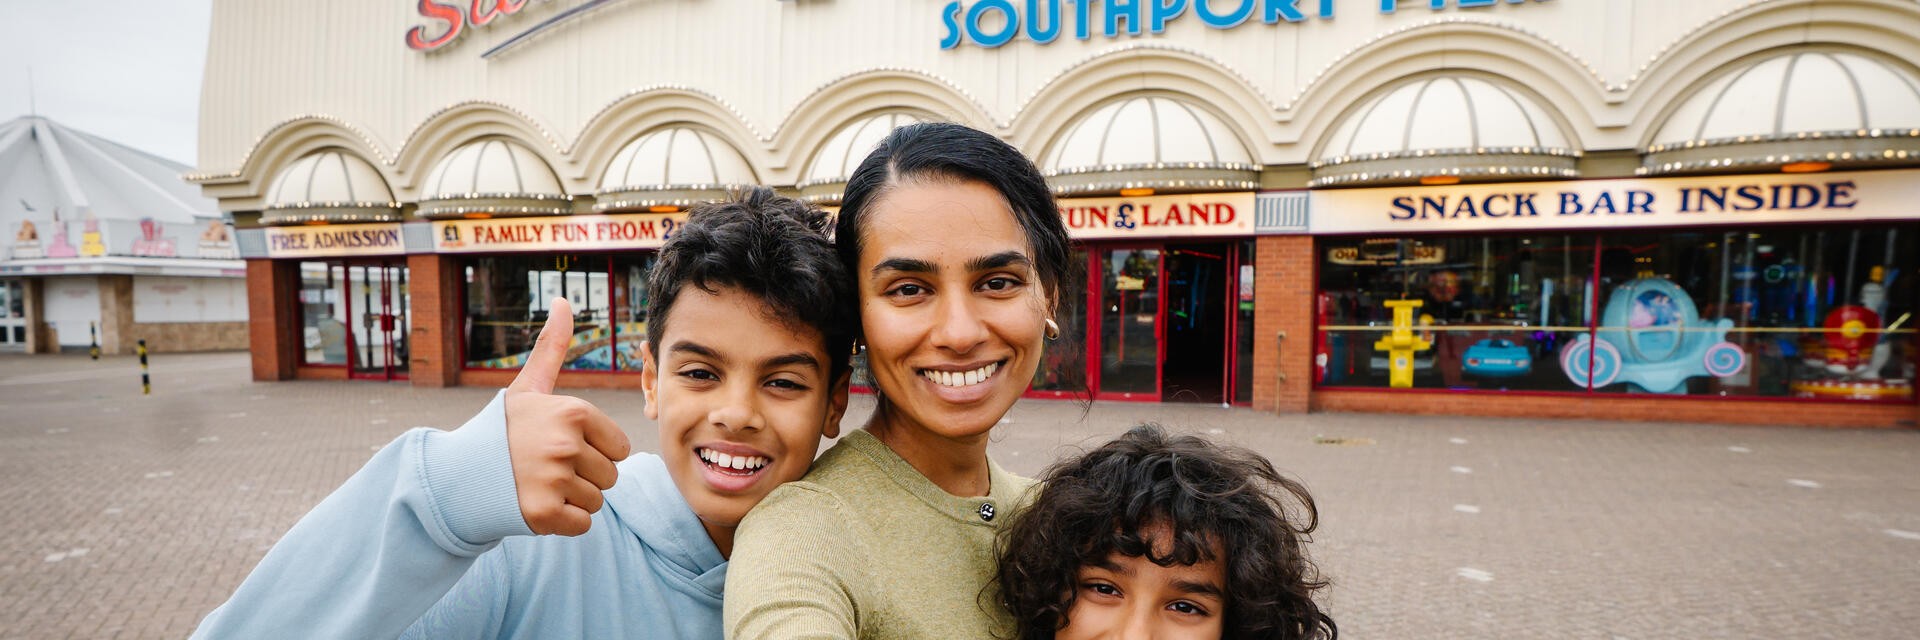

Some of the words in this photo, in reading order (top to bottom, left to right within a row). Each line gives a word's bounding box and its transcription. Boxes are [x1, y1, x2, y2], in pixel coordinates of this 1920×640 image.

[1389, 192, 1539, 220] SNACK
[1557, 190, 1656, 215] BAR
[1677, 180, 1859, 212] INSIDE
[271, 231, 310, 250] FREE
[313, 229, 399, 249] ADMISSION
[473, 224, 544, 244] FAMILY
[551, 222, 588, 241] FUN
[597, 220, 657, 240] FROM
